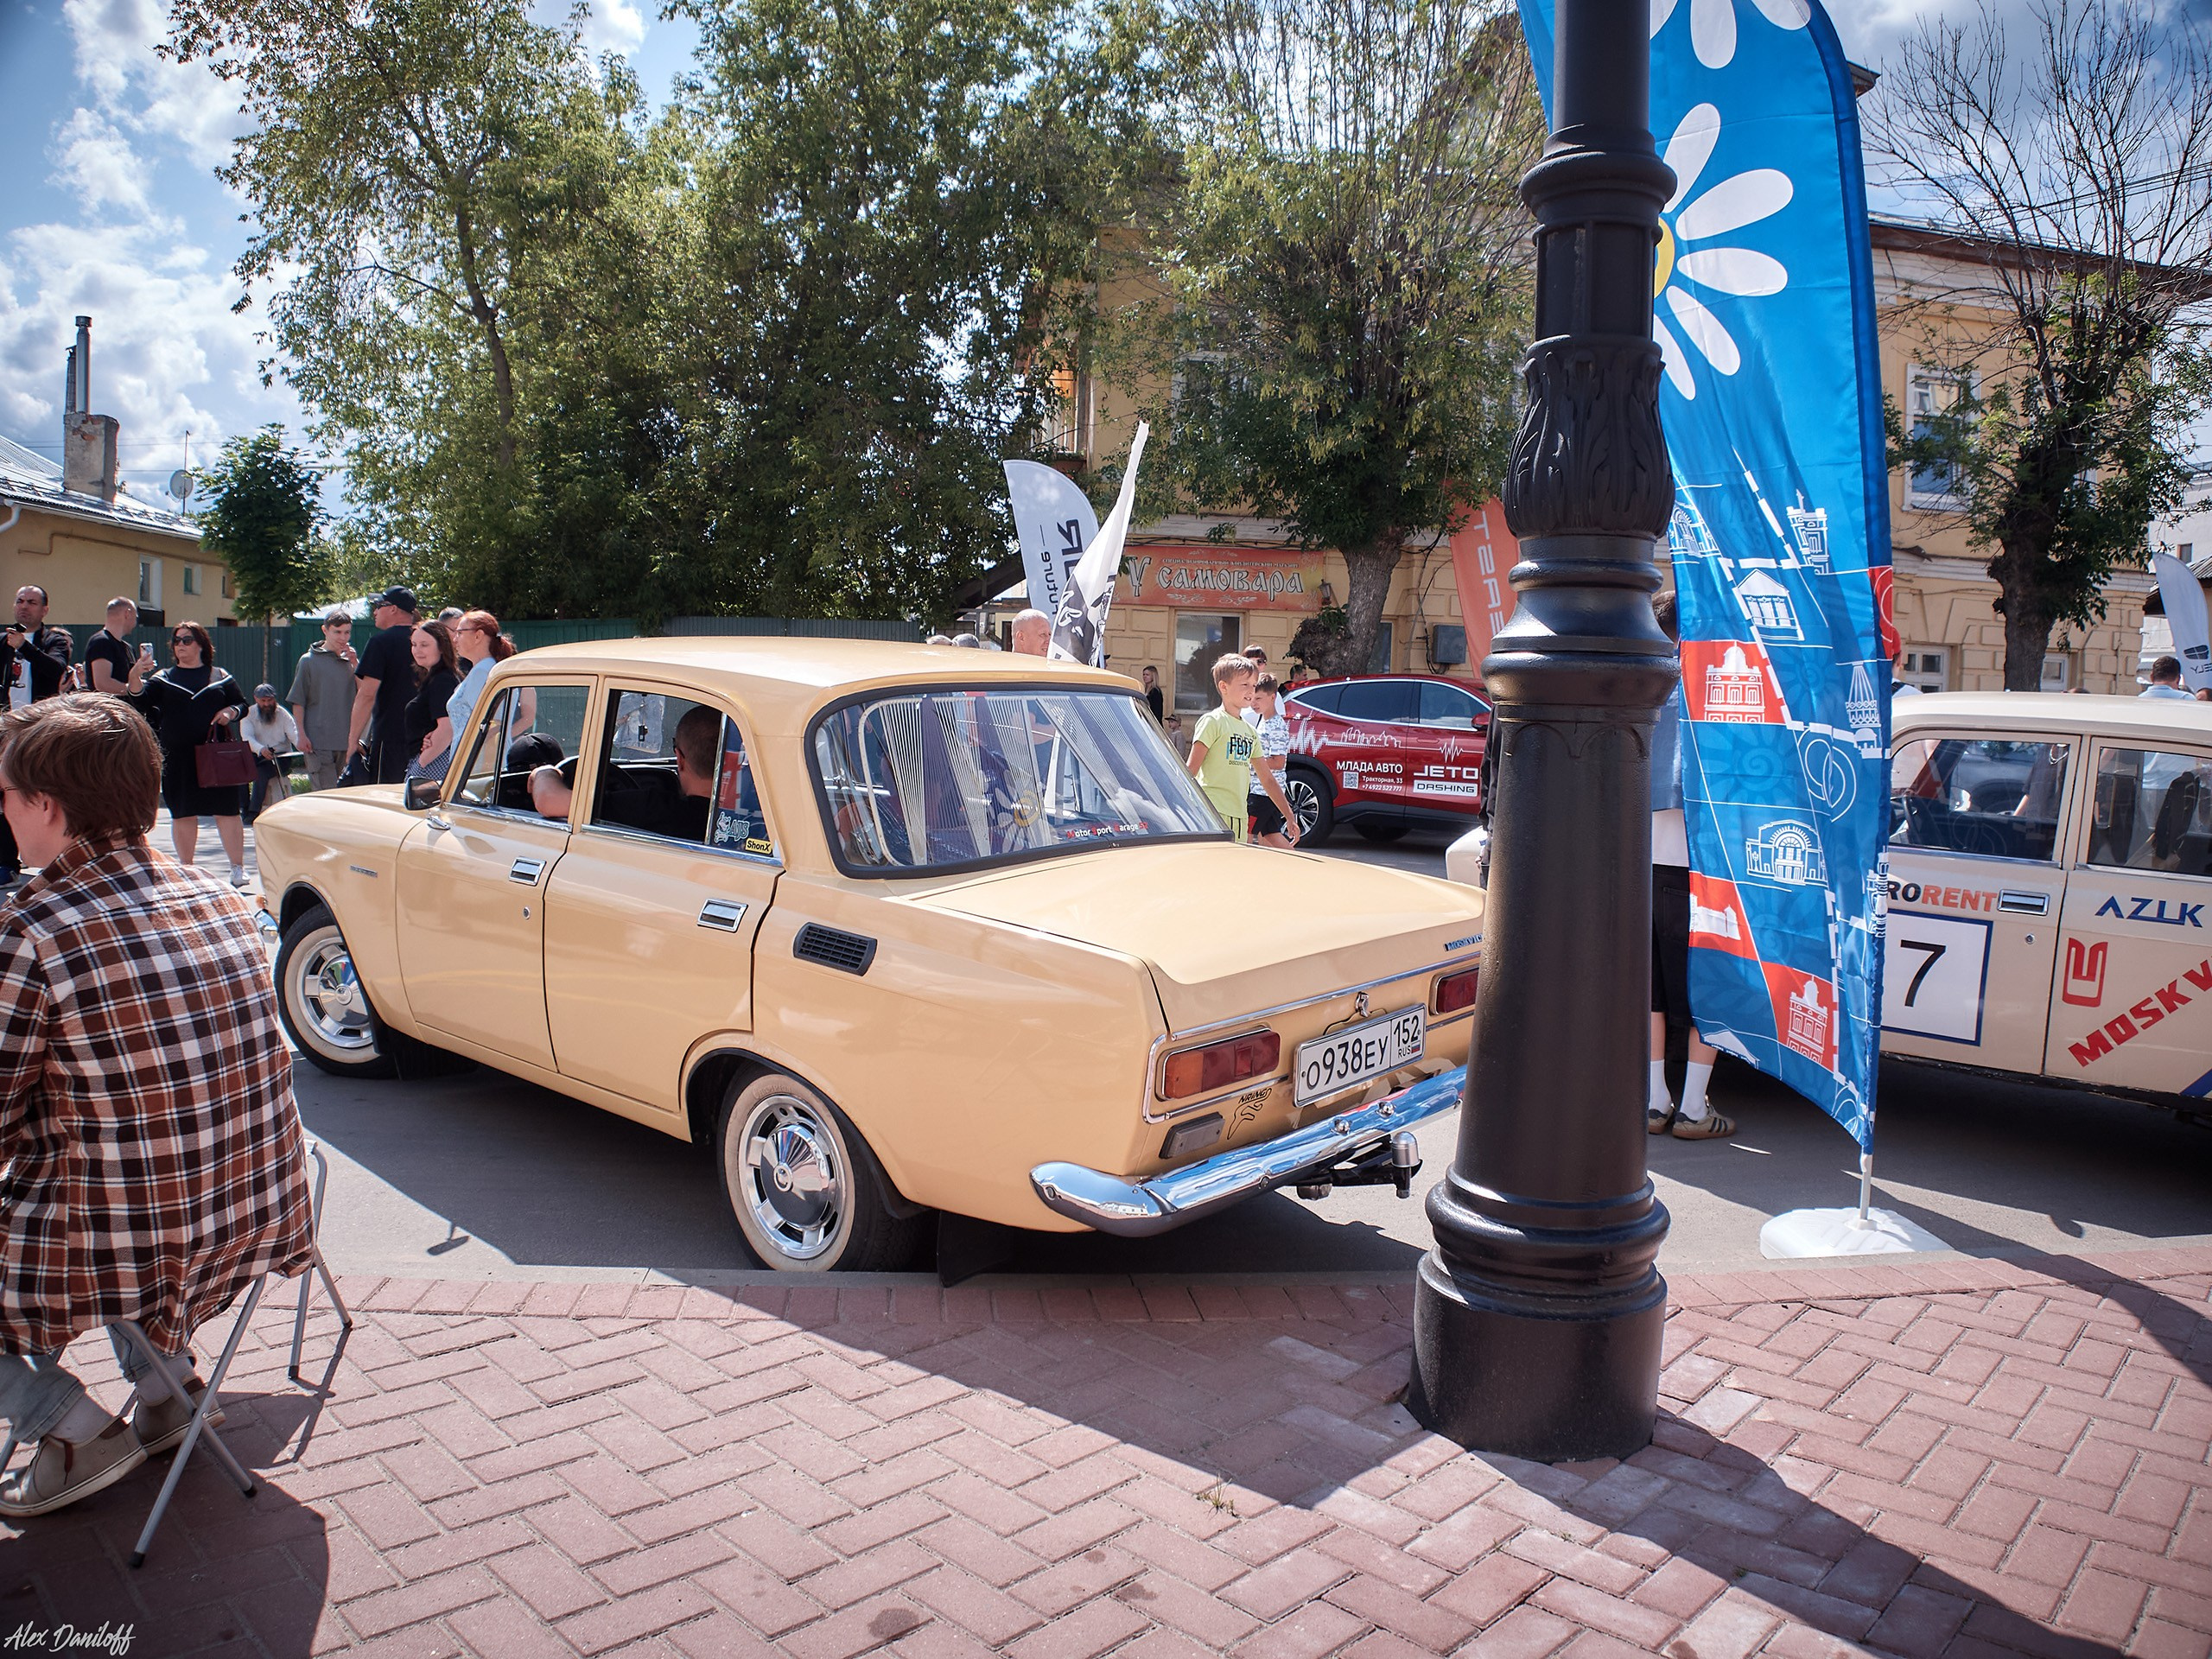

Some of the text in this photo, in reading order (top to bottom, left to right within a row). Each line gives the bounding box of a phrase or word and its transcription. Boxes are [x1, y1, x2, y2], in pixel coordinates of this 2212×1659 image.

[1336, 760, 1403, 773] МЛАДА АВТО
[1414, 765, 1479, 779] JETO
[1362, 775, 1395, 784] Тракторная,
[1417, 783, 1475, 793] DASHING
[1066, 829, 1091, 839] Motor
[1091, 825, 1112, 837] Sport
[747, 840, 771, 852] ShonX
[1886, 880, 1999, 912] RORENT
[1900, 938, 1947, 1008] 7
[2068, 955, 2212, 1068] MOSKV
[1394, 1014, 1420, 1047] 152
[1397, 1045, 1411, 1059] RUS
